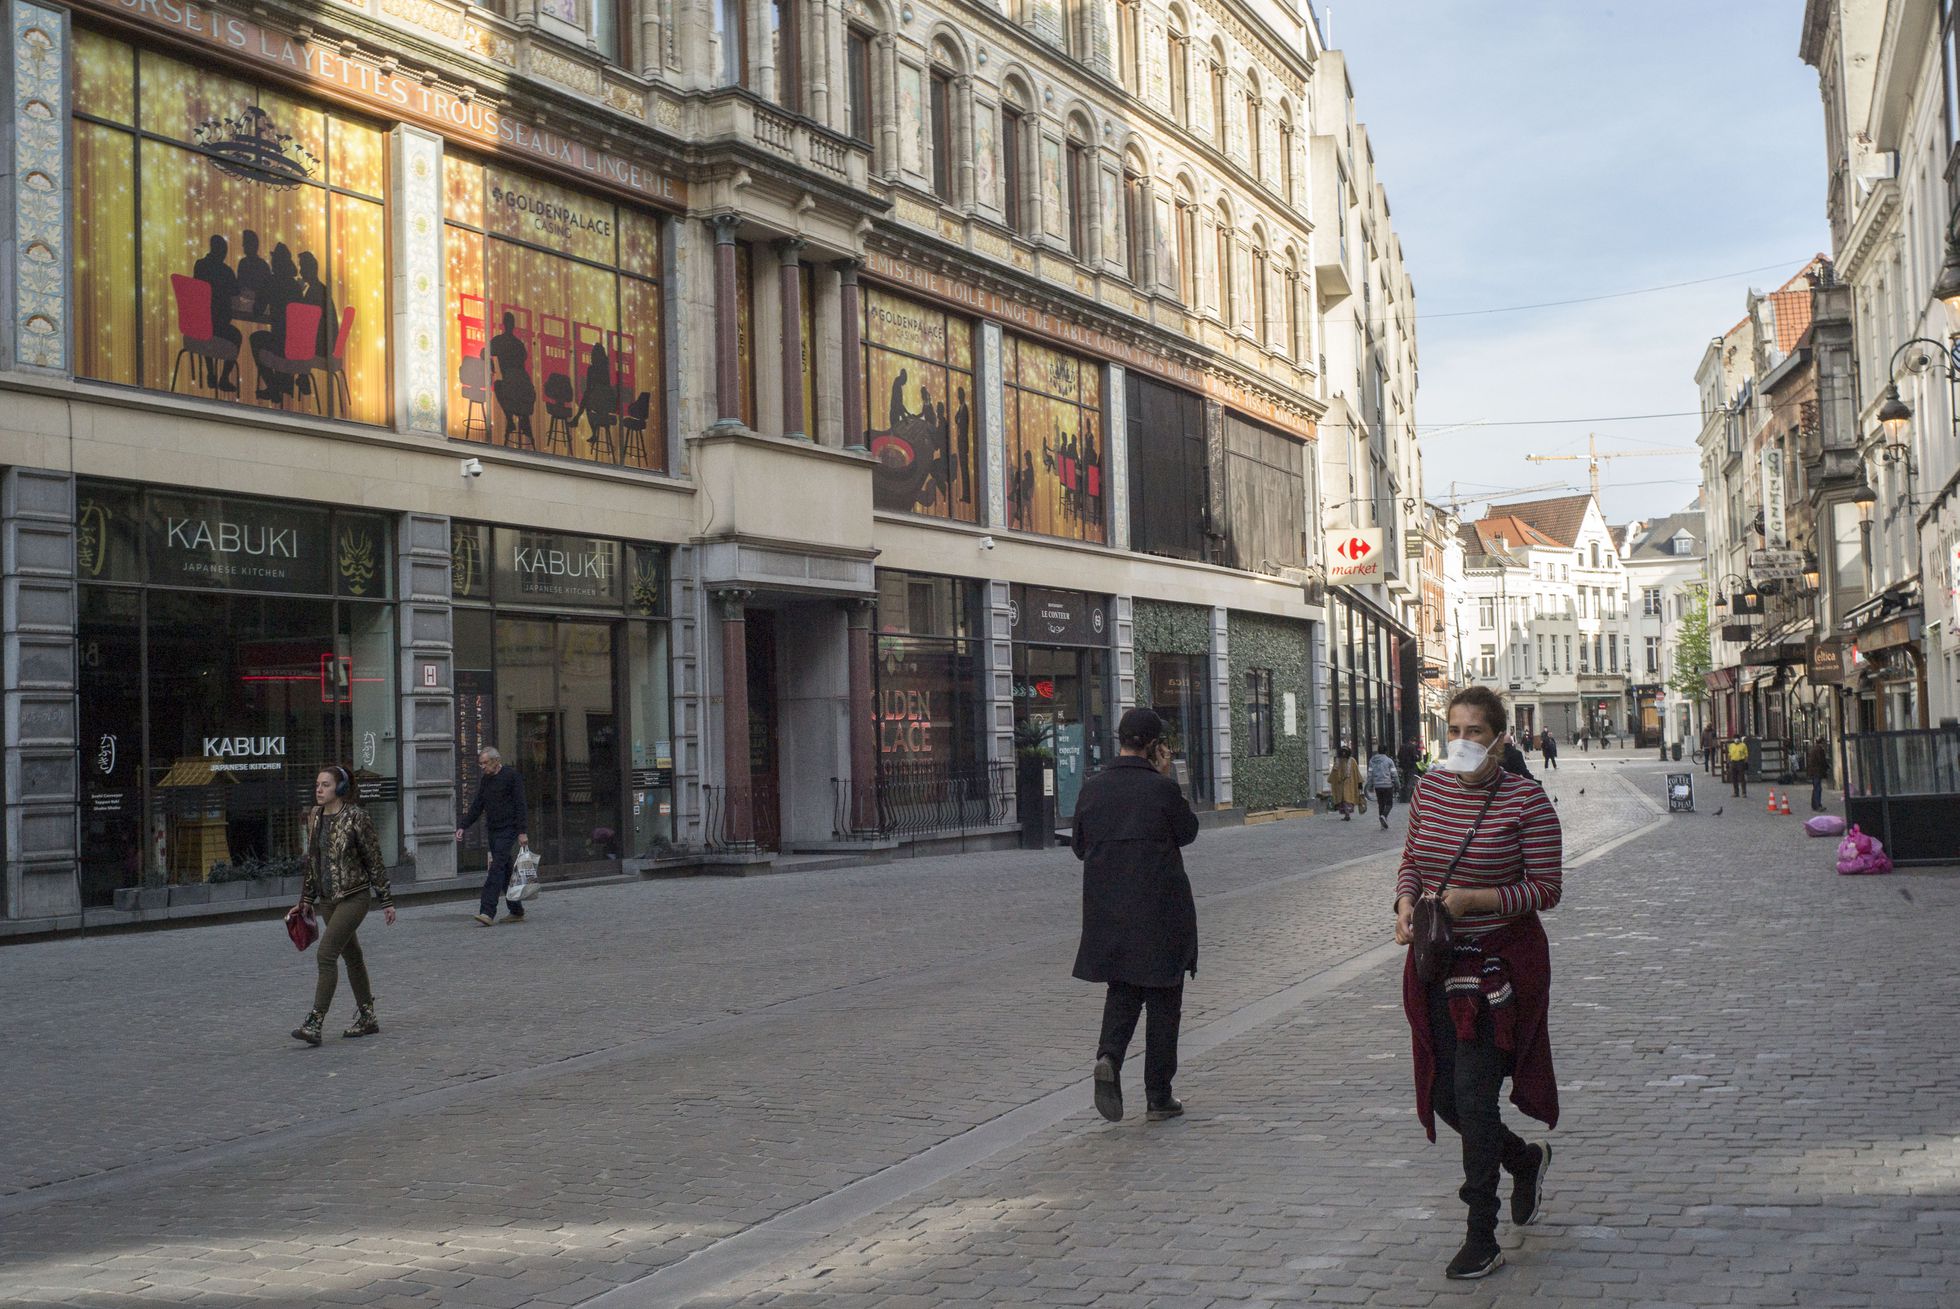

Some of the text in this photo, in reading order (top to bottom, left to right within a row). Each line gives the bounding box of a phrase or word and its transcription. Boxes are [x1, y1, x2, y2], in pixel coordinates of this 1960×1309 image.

[121, 0, 674, 199] RSETS LAYETTES TROUSSEAUX LINGERIE
[506, 191, 610, 237] GOLDENPALACE
[534, 218, 572, 240] CASINO
[868, 252, 938, 291] EMISERIE
[944, 279, 985, 309] TOILE
[991, 296, 1029, 323] LINGE
[1034, 311, 1050, 330] DE
[1055, 319, 1092, 346] TABLE
[1096, 334, 1131, 359] COTON
[1135, 348, 1164, 372] TAPIS
[1245, 391, 1271, 415] TISSUS
[879, 308, 943, 339] GOLDENPALACE
[167, 517, 297, 558] KABUKI
[182, 562, 286, 578] JAPANESE KITCHEN
[514, 547, 605, 579] KABUKI
[1331, 562, 1378, 576] market
[525, 584, 596, 596] JAPANESE KITCHEN
[1041, 610, 1048, 618] LE
[870, 689, 931, 721] OLDEN
[203, 736, 286, 757] KABUKI
[872, 721, 932, 753] LACE
[210, 762, 281, 772] JAPANESE KITCHEN
